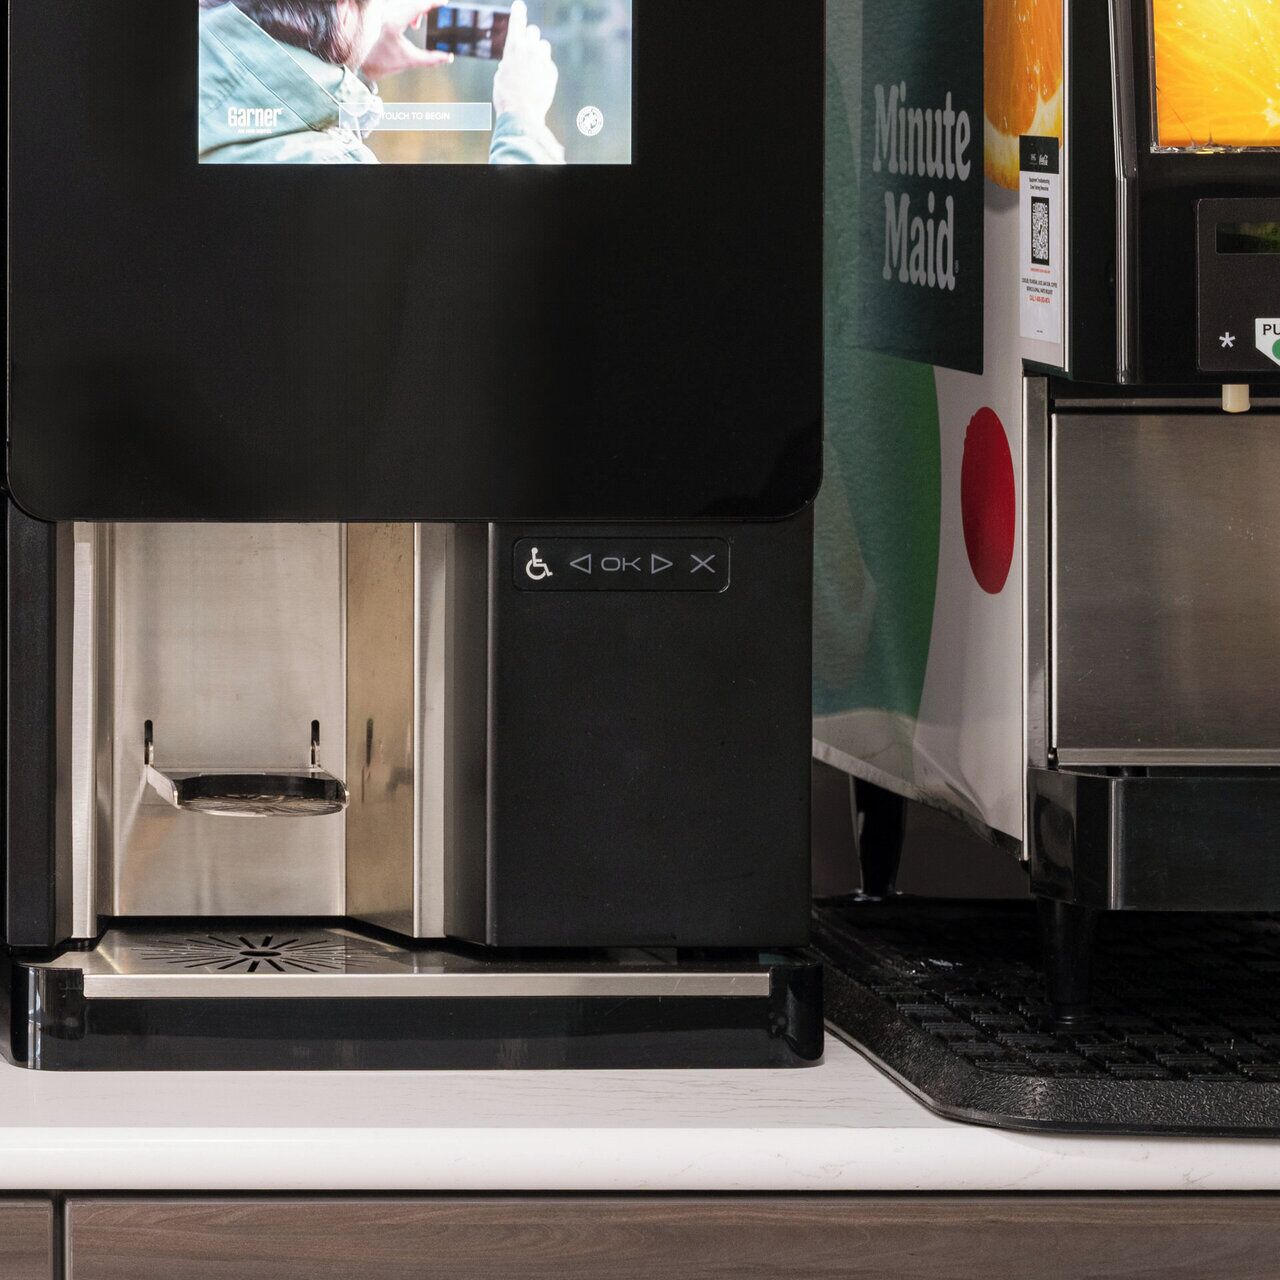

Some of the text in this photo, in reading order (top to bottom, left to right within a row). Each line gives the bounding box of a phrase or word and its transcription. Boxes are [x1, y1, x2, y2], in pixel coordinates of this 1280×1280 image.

[228, 106, 283, 127] Garner
[380, 111, 450, 120] TOUCH TO BEGIN
[872, 80, 971, 181] Minute
[882, 191, 956, 291] Maid
[601, 557, 641, 572] OK
